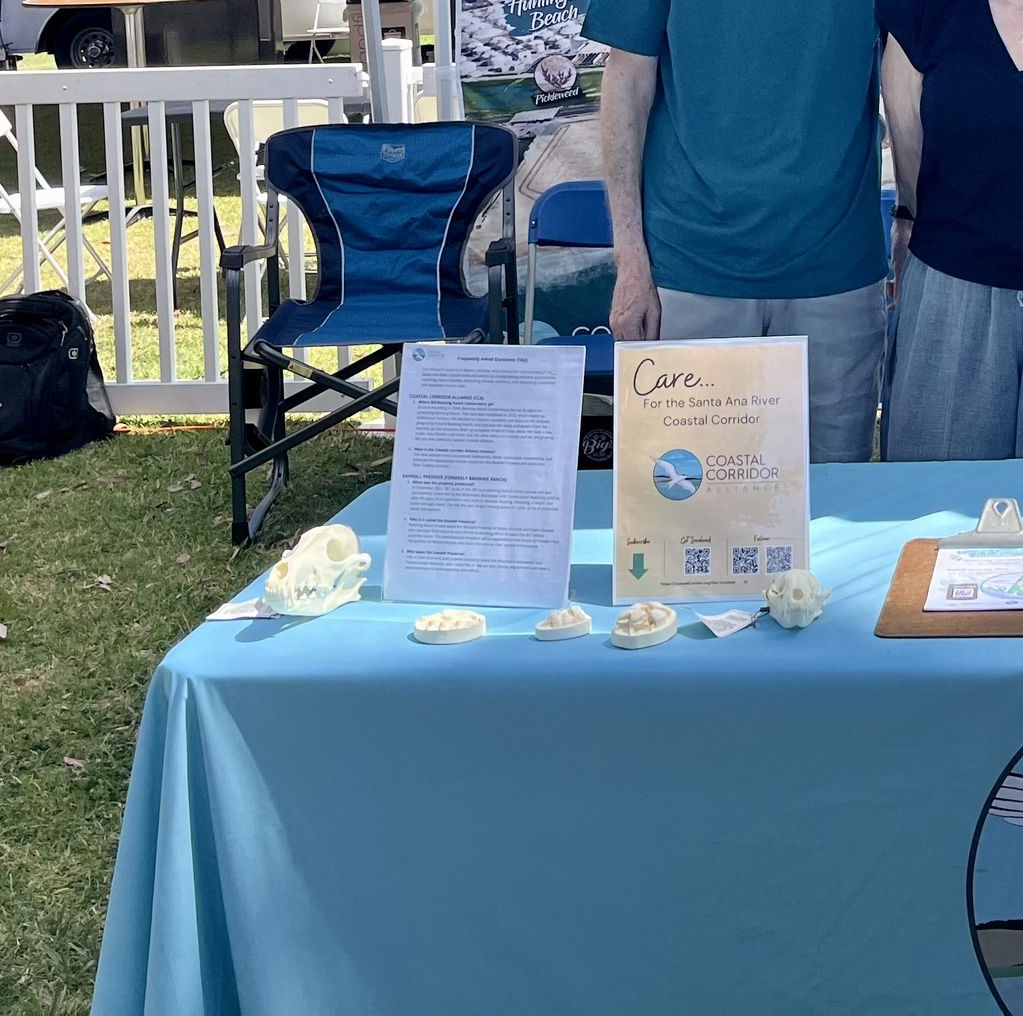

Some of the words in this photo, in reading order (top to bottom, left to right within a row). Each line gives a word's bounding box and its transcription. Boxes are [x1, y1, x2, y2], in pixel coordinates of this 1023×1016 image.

[528, 5, 579, 32] Beach
[535, 87, 579, 105] Pickleweed
[632, 358, 715, 396] Care...
[643, 399, 662, 409] For
[666, 397, 685, 408] the
[688, 396, 722, 408] Santa
[725, 396, 748, 406] Ana
[751, 395, 780, 406] River
[663, 415, 708, 427] Coastal
[711, 414, 761, 426] Corridor
[705, 454, 766, 467] COASTAL
[705, 467, 779, 481] CORRIDOR
[705, 484, 780, 493] ALLIANCE
